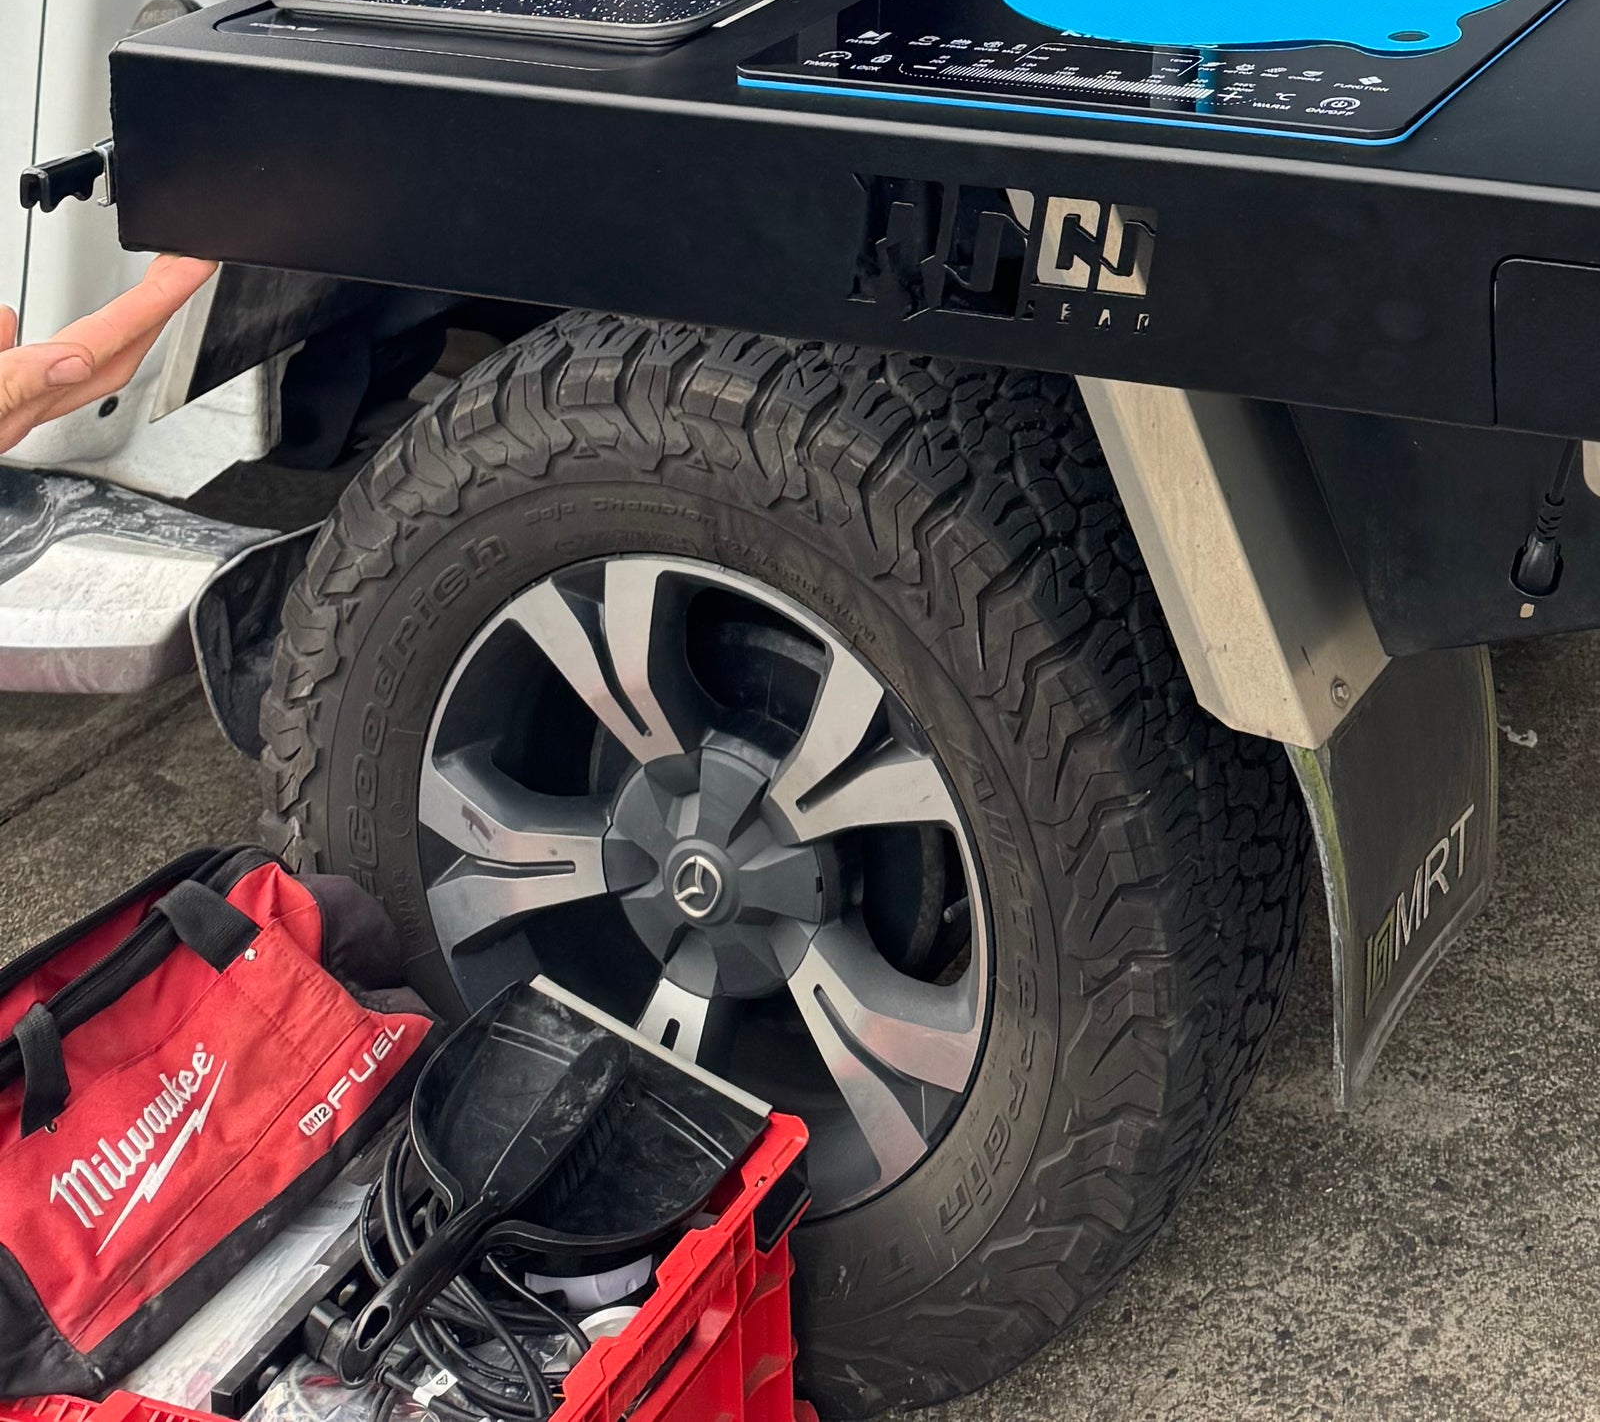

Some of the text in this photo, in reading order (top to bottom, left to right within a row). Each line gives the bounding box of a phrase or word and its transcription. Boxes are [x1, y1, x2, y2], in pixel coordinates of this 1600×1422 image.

[802, 58, 841, 68] TIMER
[849, 63, 882, 72] LOCK
[1332, 82, 1390, 93] FUNCTION
[1252, 101, 1291, 110] WARM
[1305, 107, 1355, 117] ON/OFF
[301, 1024, 406, 1134] M12 FUEL
[49, 1052, 214, 1229] Milwaukee
